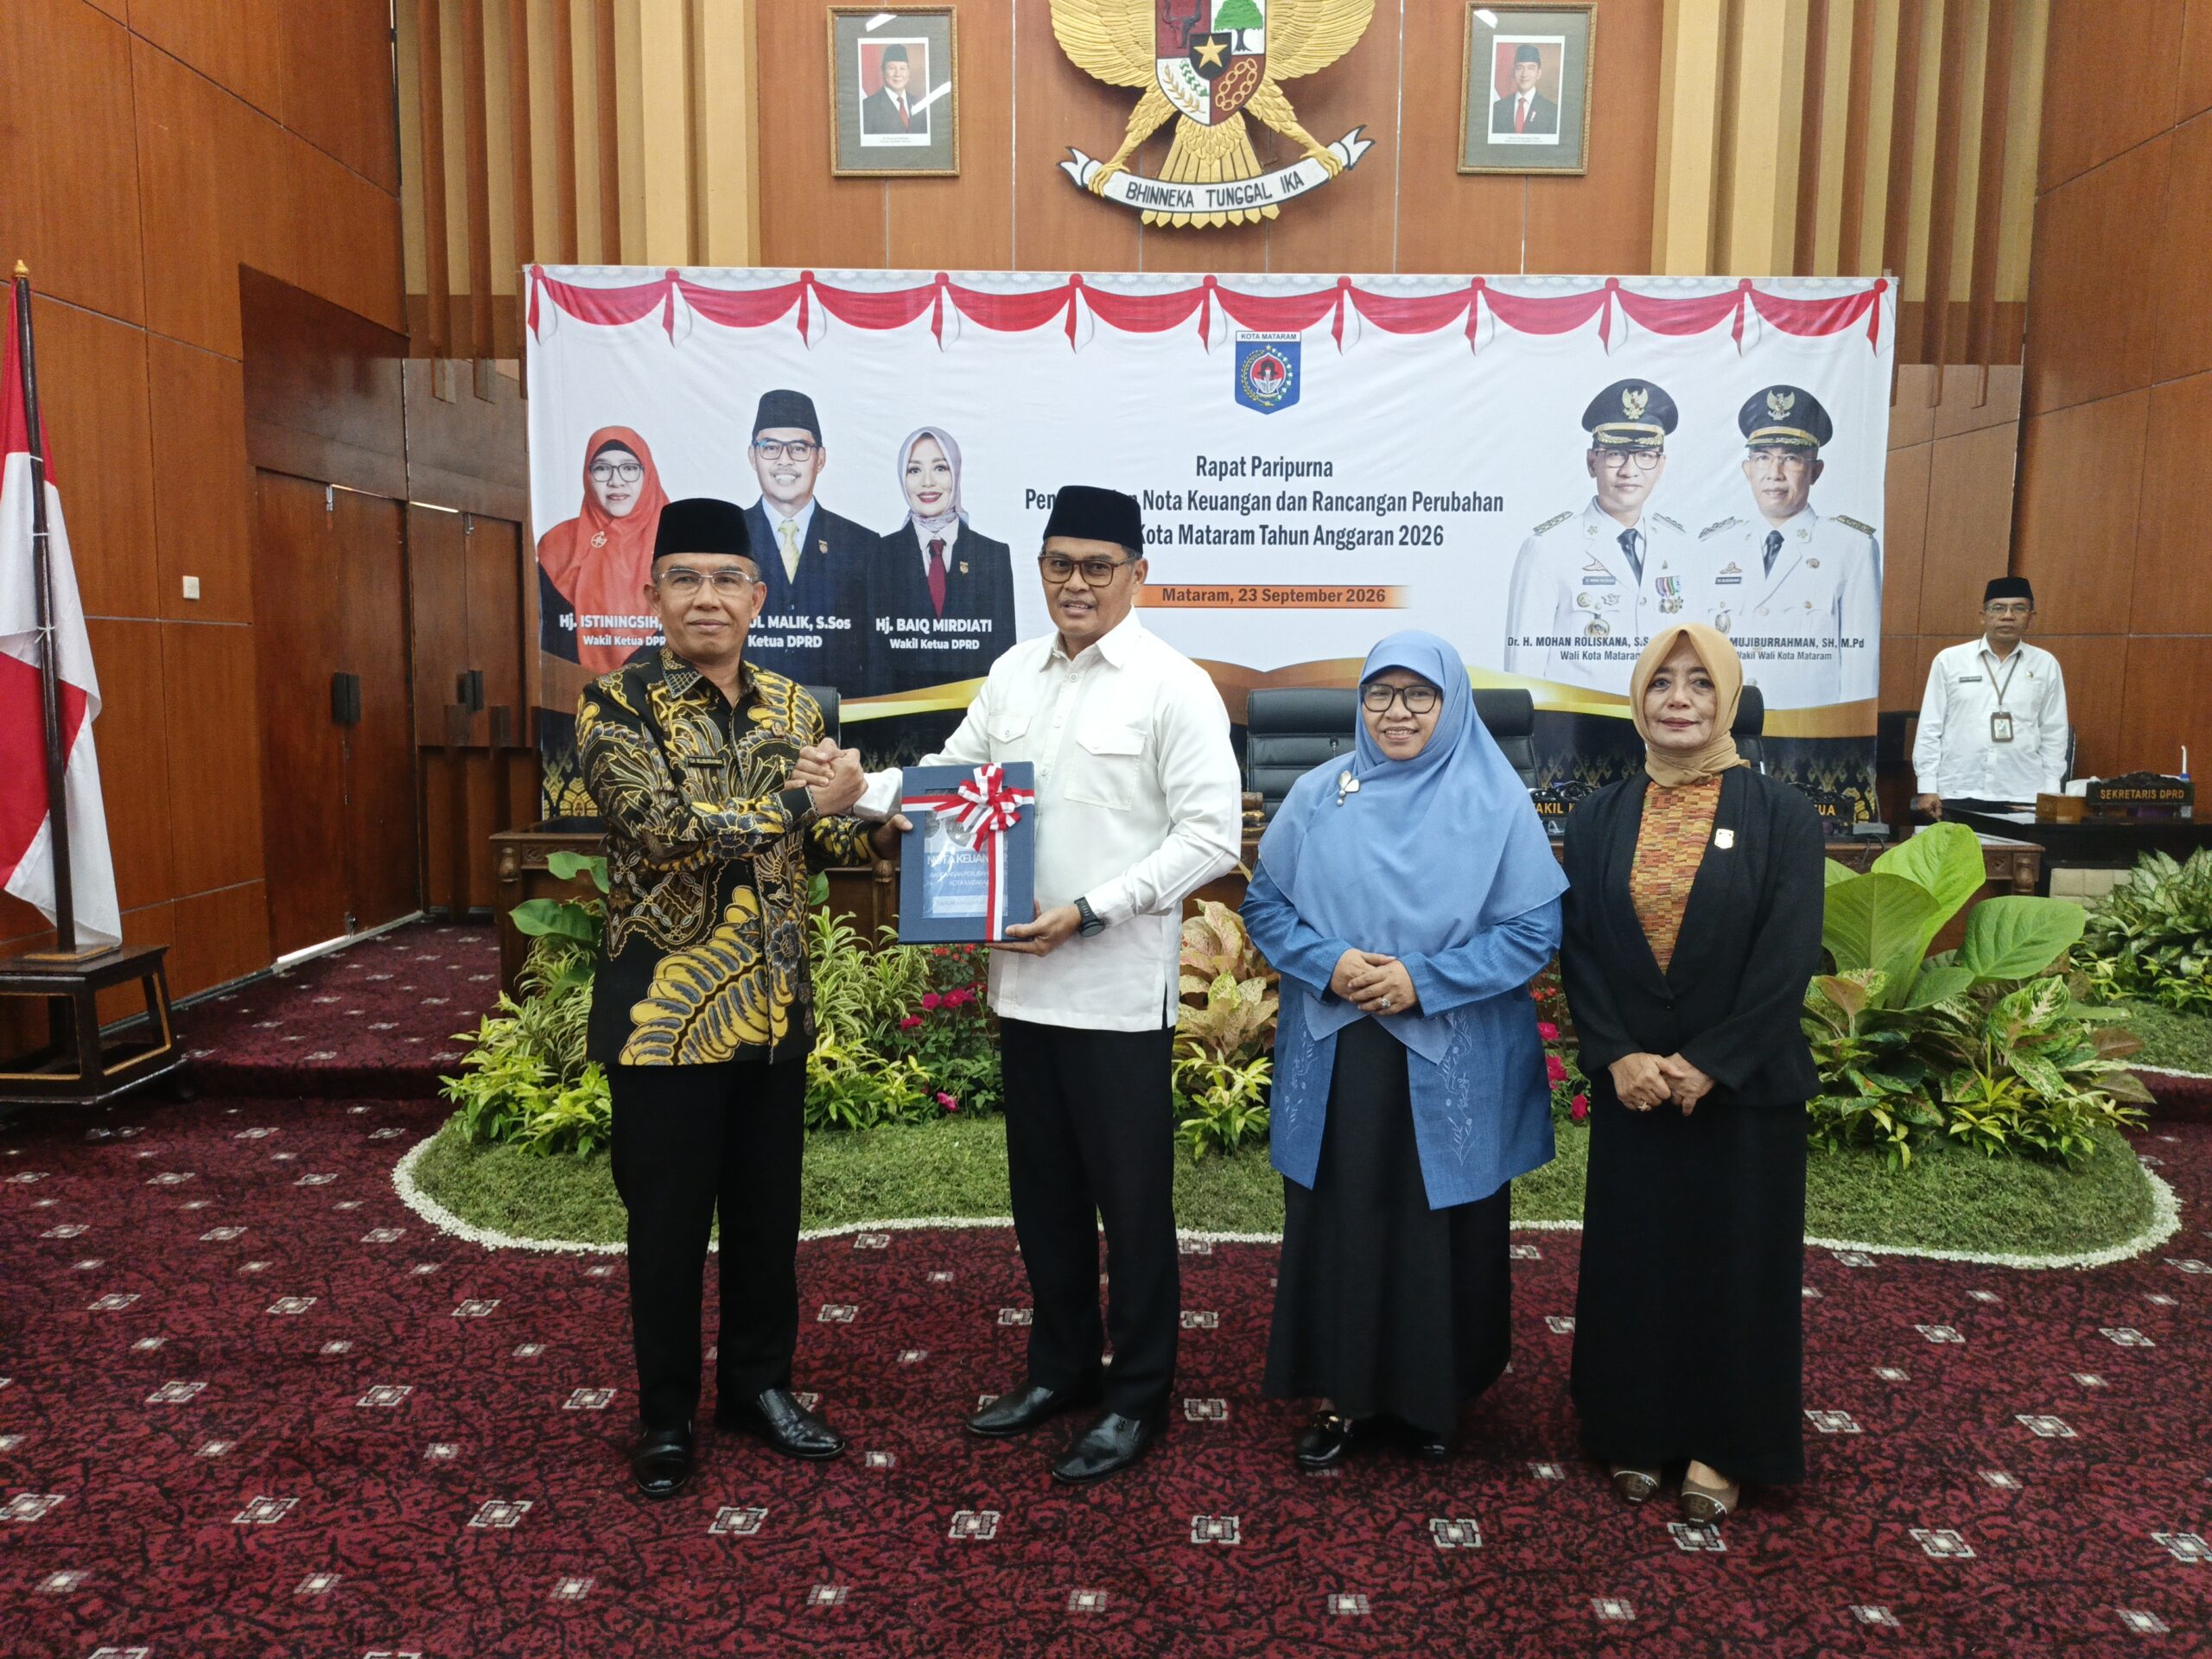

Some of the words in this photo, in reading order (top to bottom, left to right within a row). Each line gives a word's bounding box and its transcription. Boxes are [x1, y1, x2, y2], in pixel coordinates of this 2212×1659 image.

[1126, 181, 1194, 207] BHINNEKA
[1205, 182, 1273, 207] TUNGGAL
[1280, 170, 1305, 194] IKA
[1196, 455, 1247, 481] Rapat
[1251, 455, 1333, 482] Paripurna
[1143, 489, 1182, 511] Nota
[1187, 489, 1271, 516] Keuangan
[1276, 490, 1307, 512] dan
[1313, 490, 1407, 517] Rancangan
[1412, 491, 1503, 512] Perubahan
[1179, 524, 1255, 545] Mataram
[1259, 524, 1309, 545] Tahun
[1313, 524, 1394, 550] Anggaran
[1398, 524, 1444, 546] 2026
[1162, 588, 1234, 604] Mataram,
[1238, 588, 1257, 602] 23
[1262, 588, 1343, 605] September
[1346, 588, 1386, 602] 2026
[559, 613, 577, 631] Hj.
[580, 614, 663, 631] ISTININGSIH,
[767, 615, 813, 632] MALIK,
[816, 616, 851, 629] S.Sos
[875, 616, 893, 634] Hj.
[896, 618, 931, 634] BAIQ
[932, 619, 992, 632] MIRDIATI
[583, 634, 612, 645] Wakil
[613, 636, 643, 645] Ketua
[645, 636, 666, 646] DPR
[747, 634, 784, 647] Ketua
[786, 635, 823, 648] DPRD
[889, 637, 918, 649] Wakil
[920, 639, 950, 649] Ketua
[951, 639, 980, 650] DPRD
[1507, 636, 1519, 646] Dr.
[1522, 636, 1533, 646] H.
[1535, 637, 1572, 646] MOHAN
[1574, 636, 1630, 648] ROLISKANA,
[1840, 638, 1864, 648] M.Pd
[1560, 650, 1580, 660] Wali
[1582, 650, 1601, 660] Kota
[1758, 651, 1776, 660] Wali
[1777, 652, 1795, 660] Kota
[1796, 652, 1832, 660] Mataram
[2100, 789, 2157, 799] SEKRETARIS
[2159, 789, 2184, 798] DPRD
[1535, 802, 1564, 814] AKIL
[956, 853, 988, 864] KEUAN
